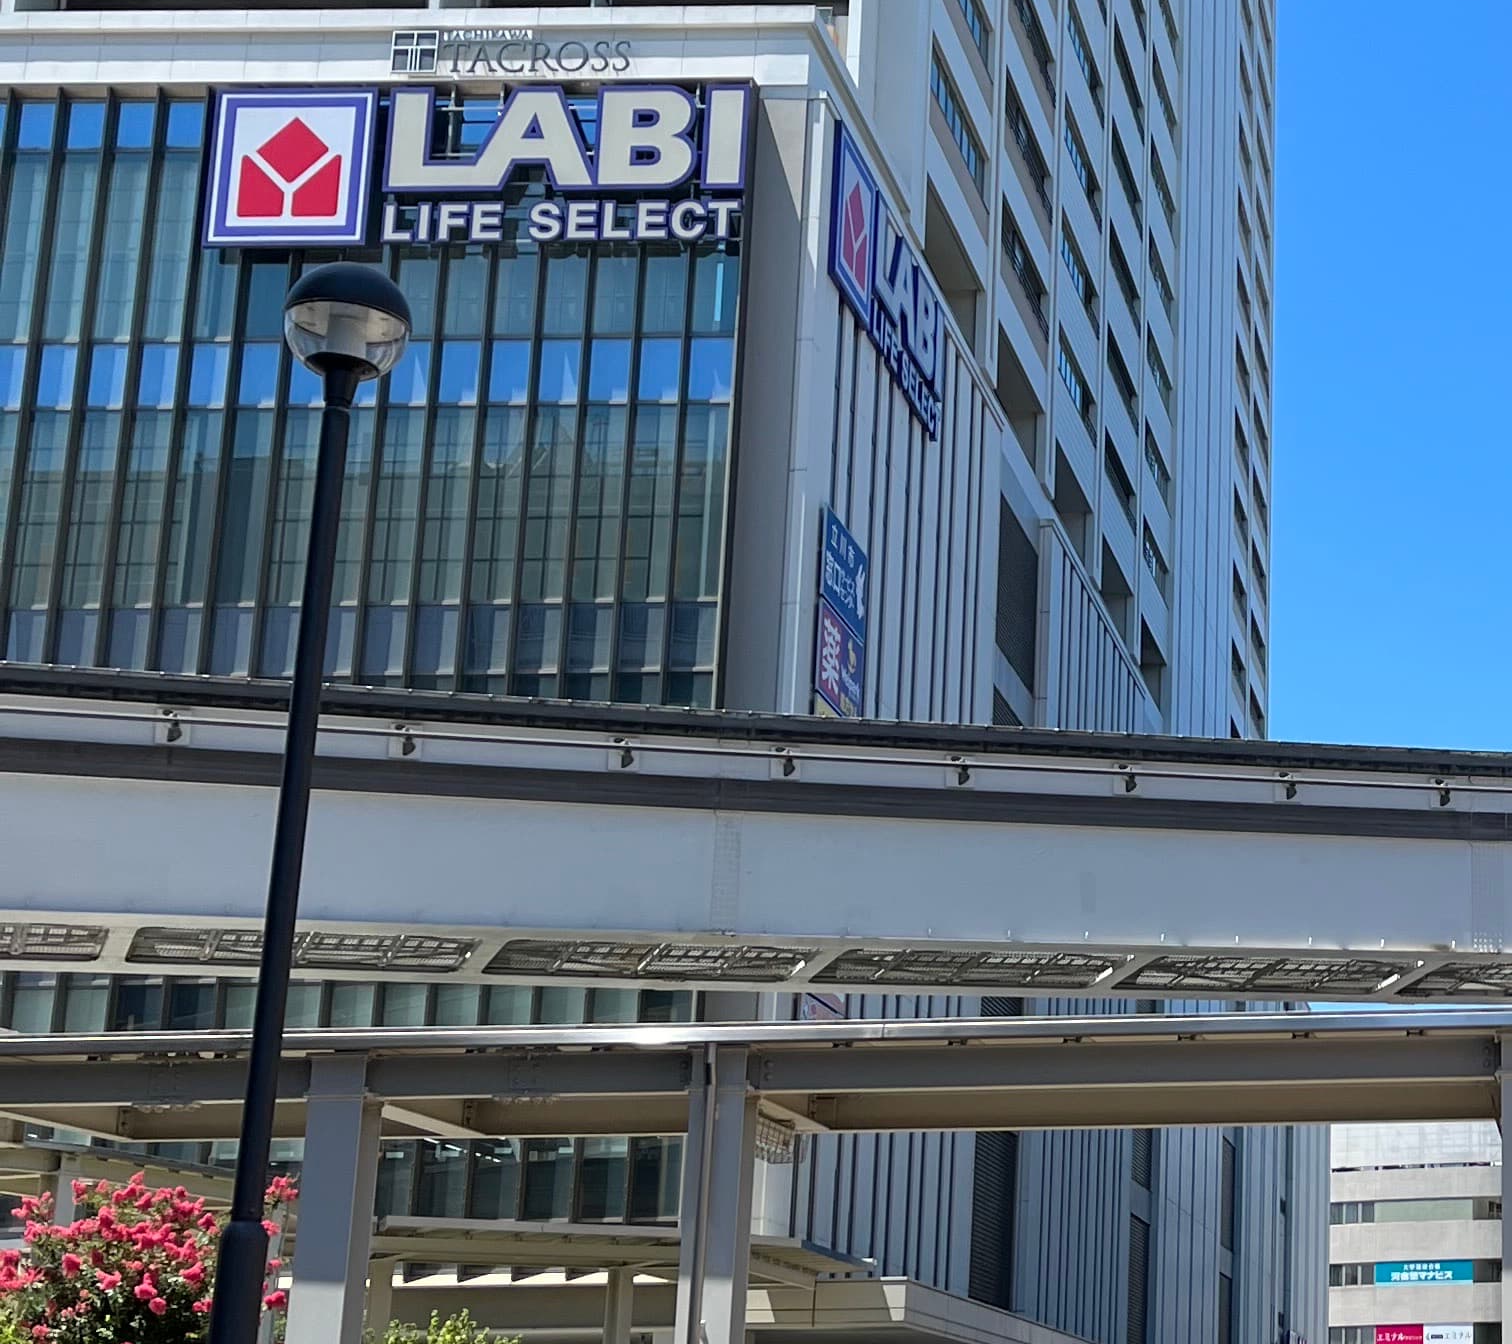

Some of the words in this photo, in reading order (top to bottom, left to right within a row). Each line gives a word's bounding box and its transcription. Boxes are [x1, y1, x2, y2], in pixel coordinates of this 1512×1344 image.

[442, 40, 632, 74] TACROSS
[383, 84, 751, 192] LABI
[380, 200, 505, 243] LIFE
[527, 199, 743, 242] SELECT
[874, 190, 946, 401] LABI
[872, 304, 900, 376] LIFE
[900, 350, 943, 439] SELECT
[821, 617, 841, 695] 薬
